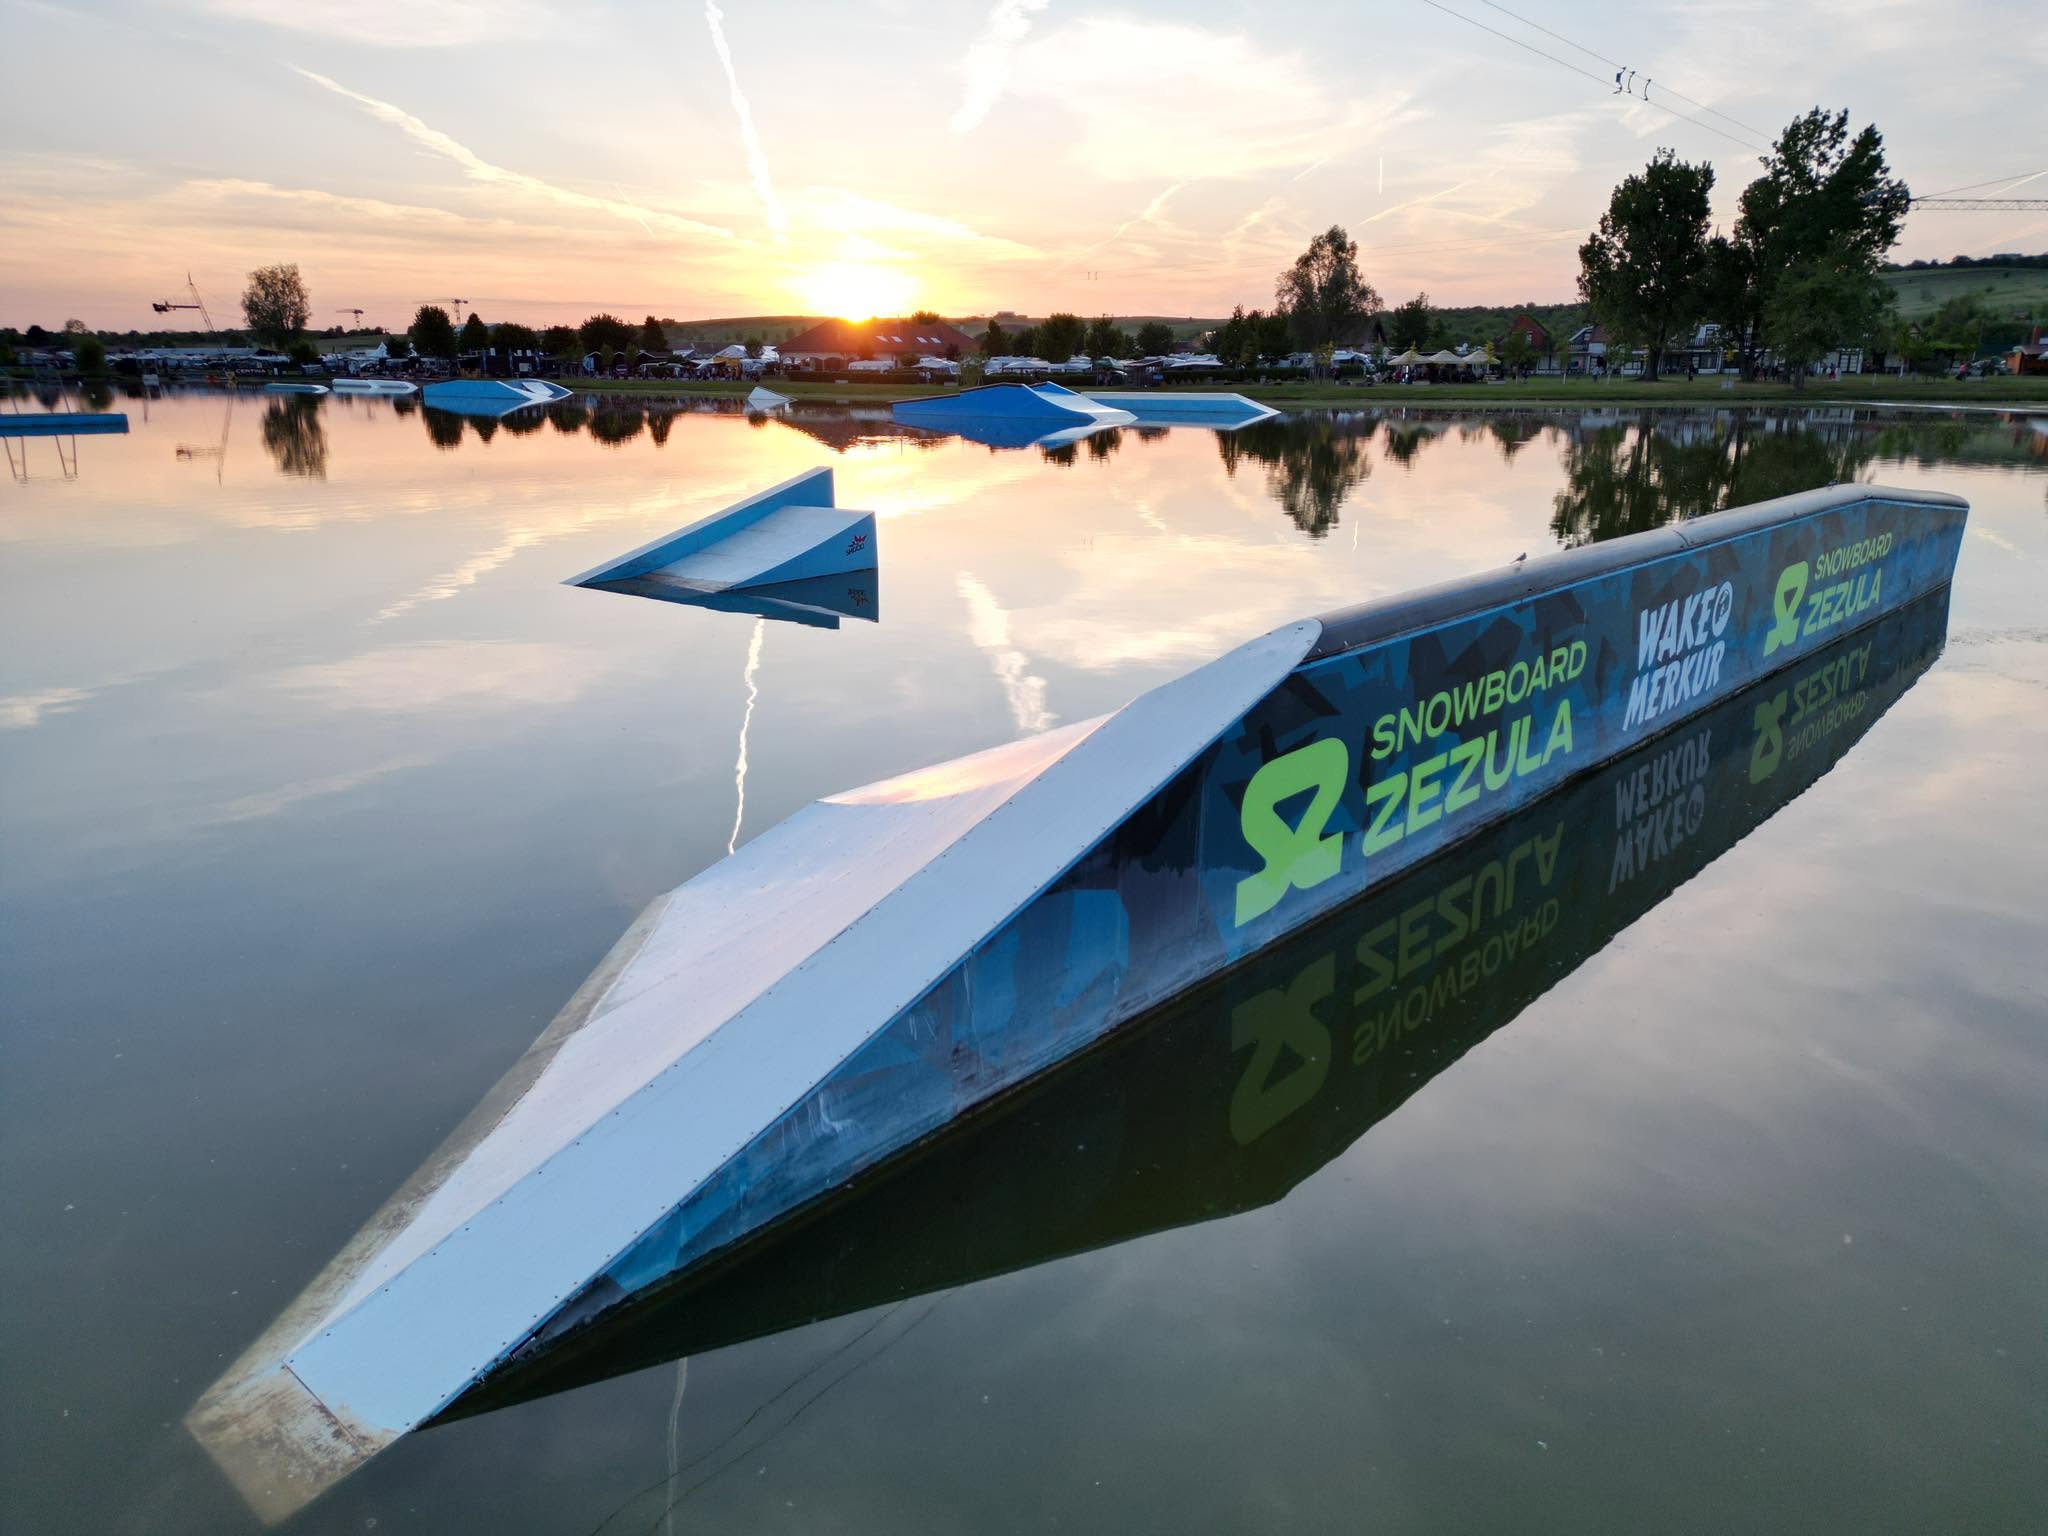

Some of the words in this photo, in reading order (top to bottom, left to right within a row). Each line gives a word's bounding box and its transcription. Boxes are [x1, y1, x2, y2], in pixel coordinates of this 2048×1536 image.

[1803, 568, 1882, 637] ZEZULA
[1815, 533, 1893, 581] SNOWBOARD
[1370, 640, 1588, 760] SNOWBOARD
[1623, 641, 1726, 732] MERKUR
[1362, 699, 1573, 857] ZEZULA
